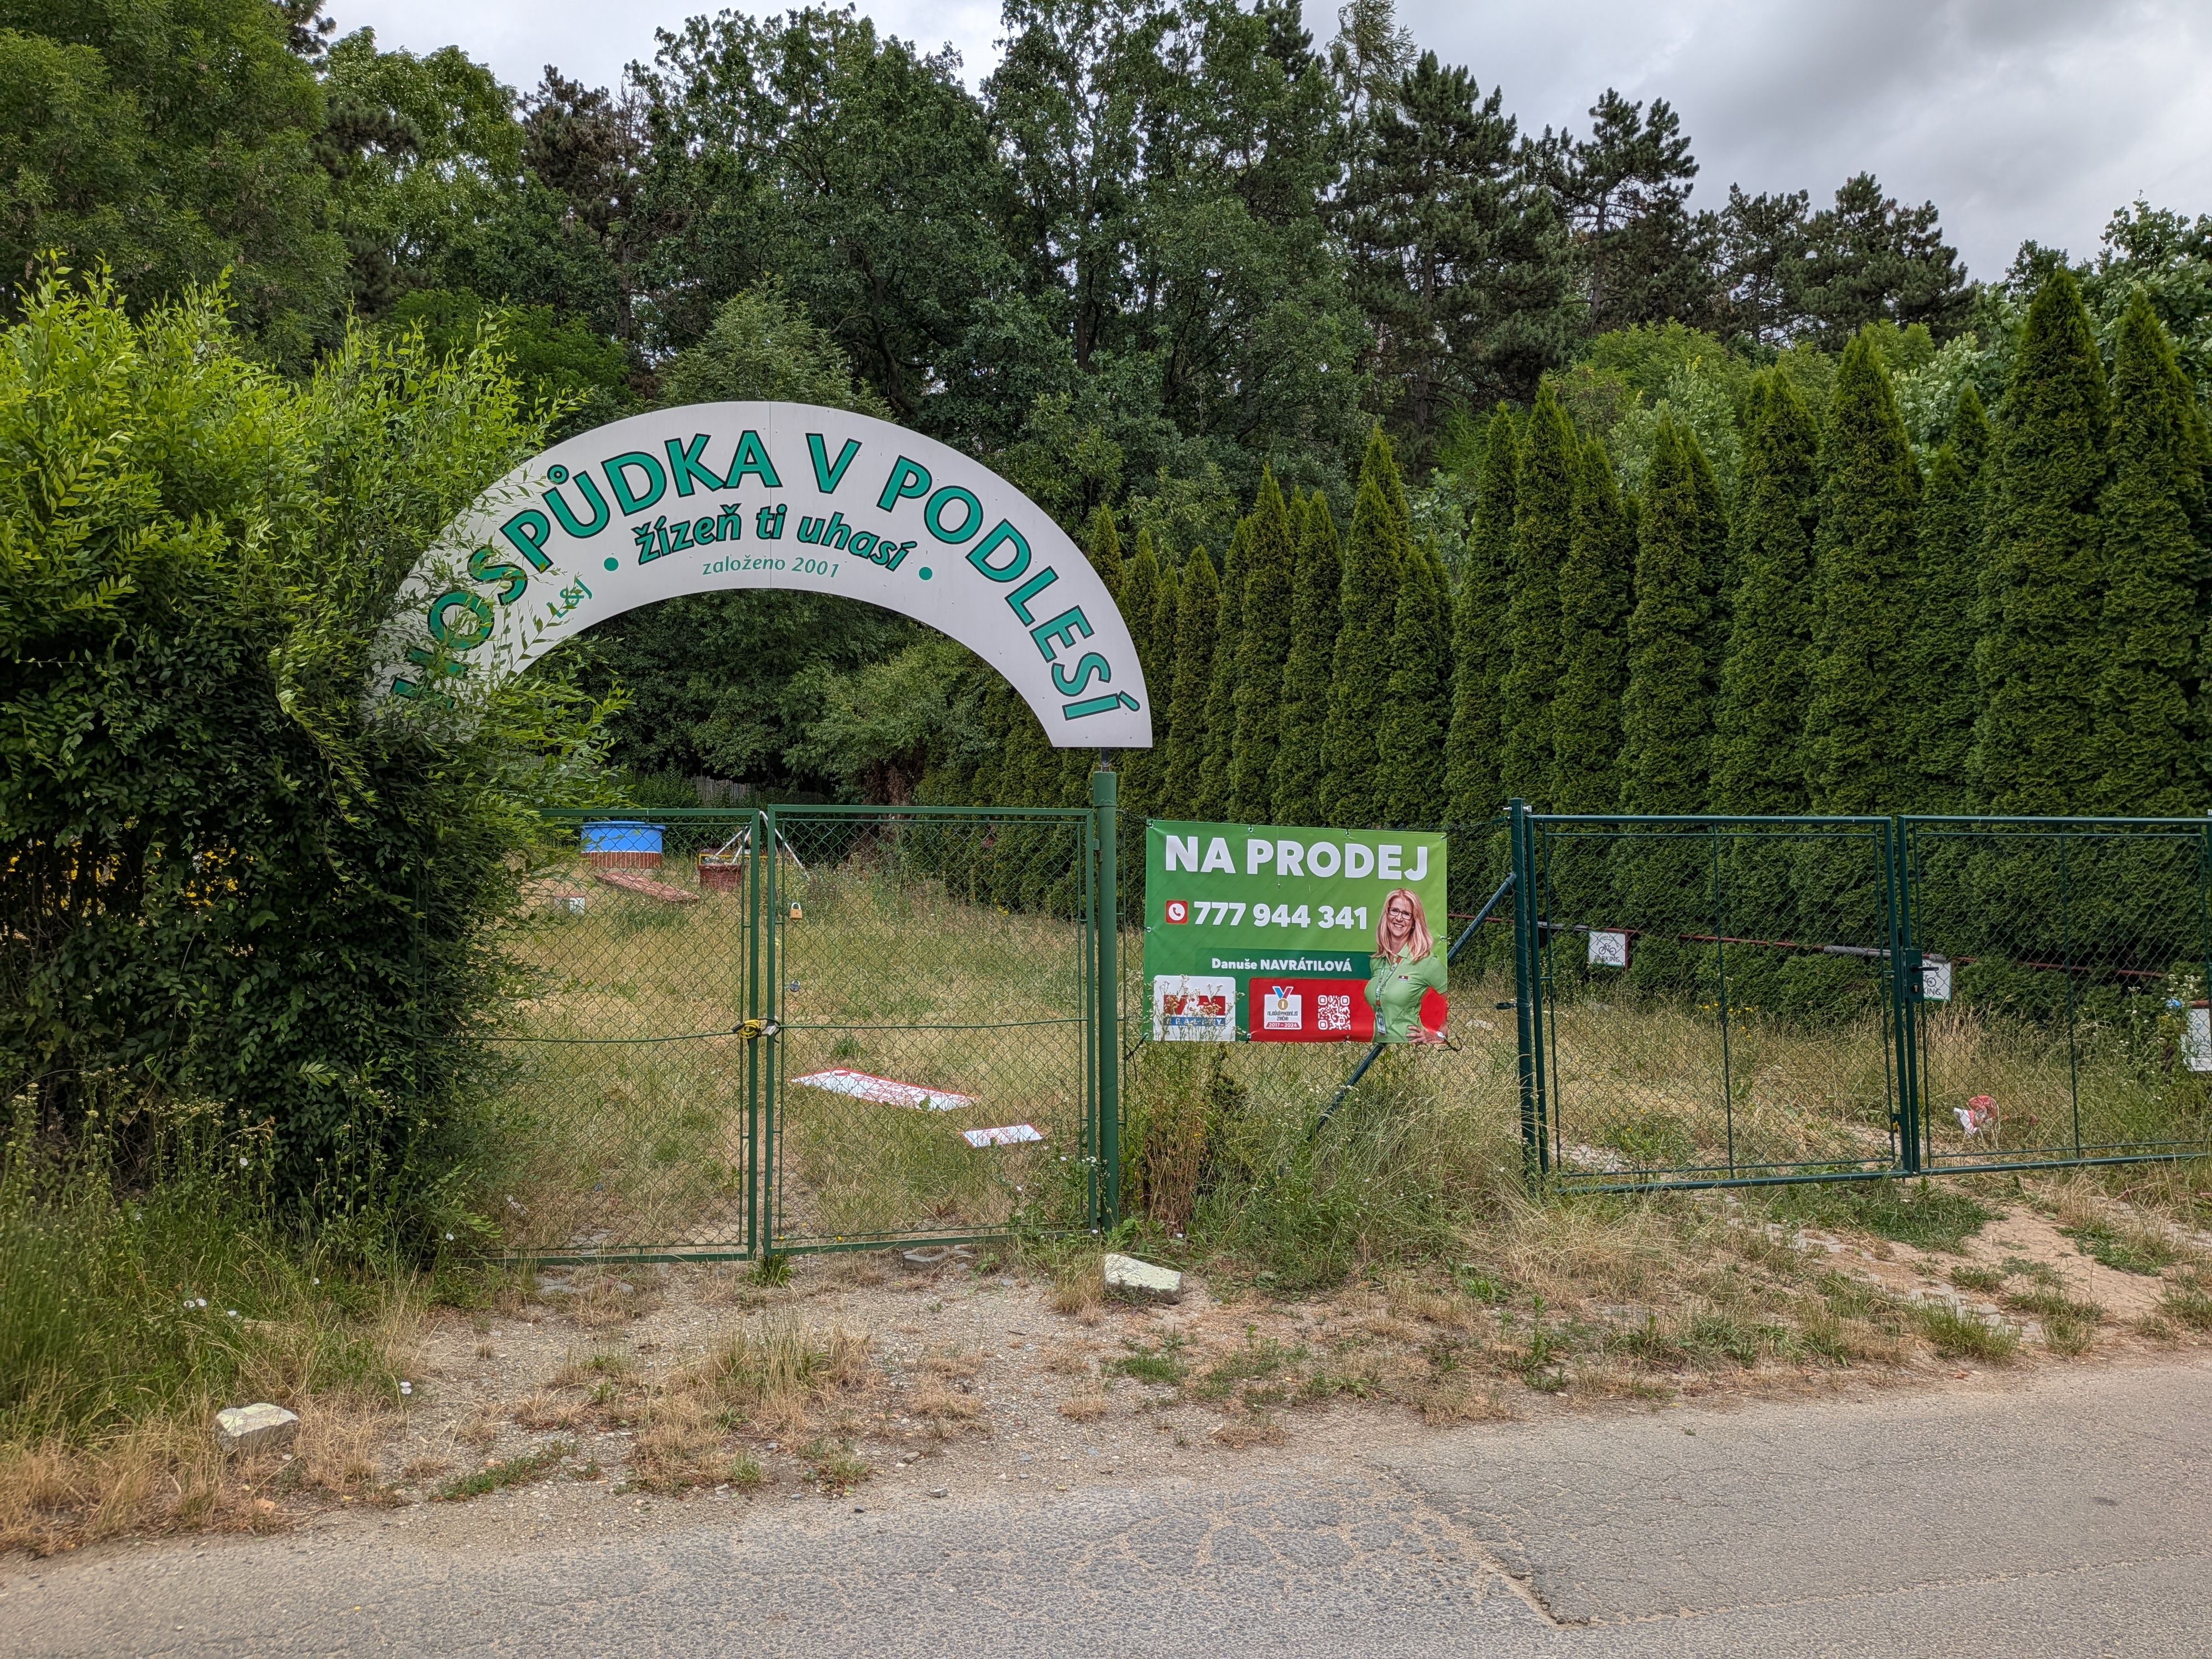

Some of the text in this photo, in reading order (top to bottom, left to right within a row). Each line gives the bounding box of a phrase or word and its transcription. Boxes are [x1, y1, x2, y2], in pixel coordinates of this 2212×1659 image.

[634, 503, 917, 571] žízeň ti uhasí
[389, 430, 1140, 721] HOSPŮDKA V PODLESÍ
[702, 554, 839, 578] založeno 2001
[1165, 834, 1428, 881] NA PRODEJ
[1193, 900, 1368, 930] 777 944 341
[1212, 957, 1353, 972] Danuše NAVRÁTILOVÁ
